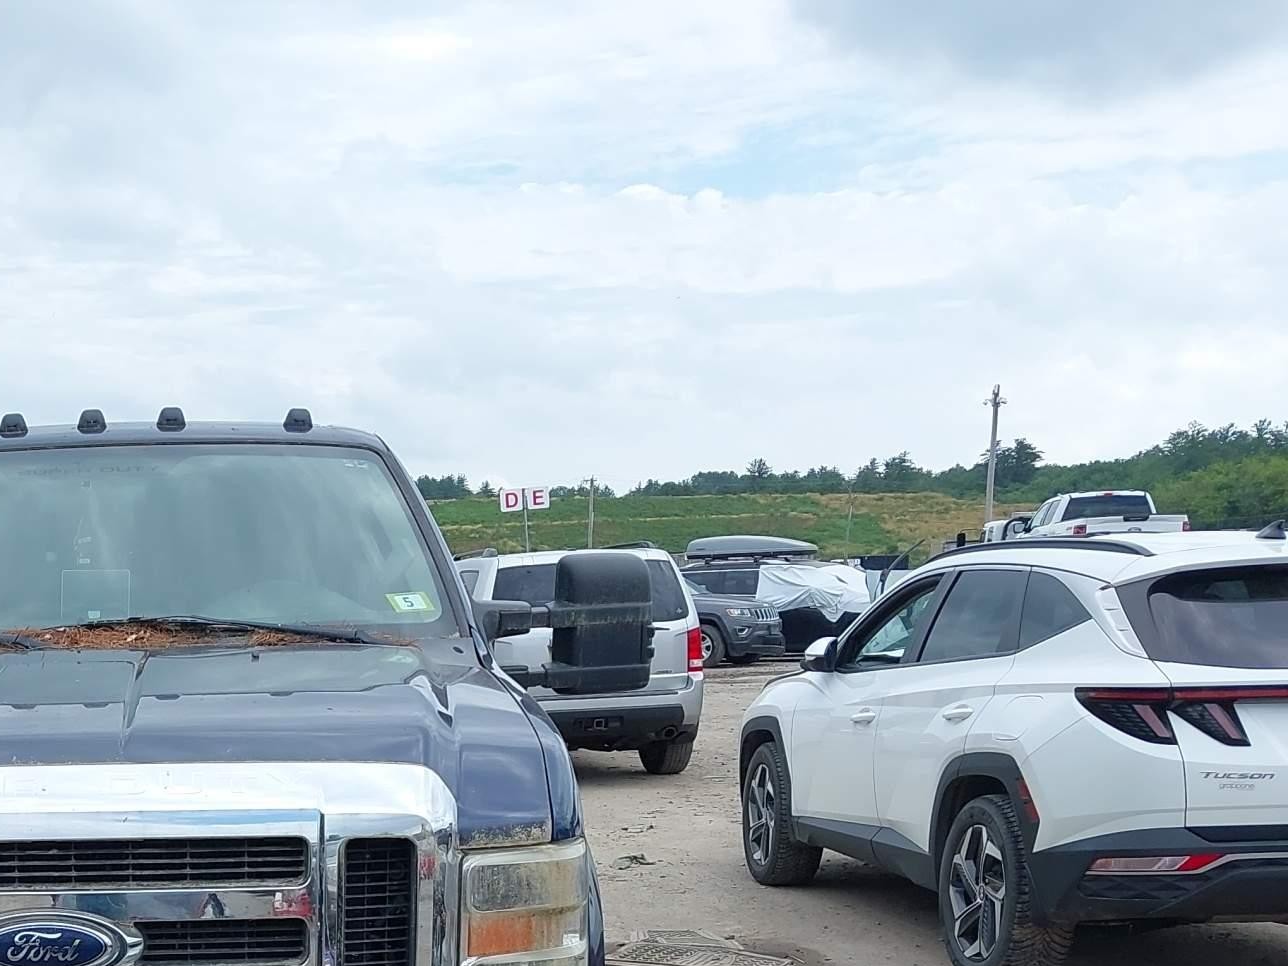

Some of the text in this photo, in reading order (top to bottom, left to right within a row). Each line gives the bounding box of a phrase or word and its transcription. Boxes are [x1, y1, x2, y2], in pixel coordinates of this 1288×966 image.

[505, 489, 545, 509] D E
[402, 596, 414, 608] 5
[6, 930, 82, 962] Ford
